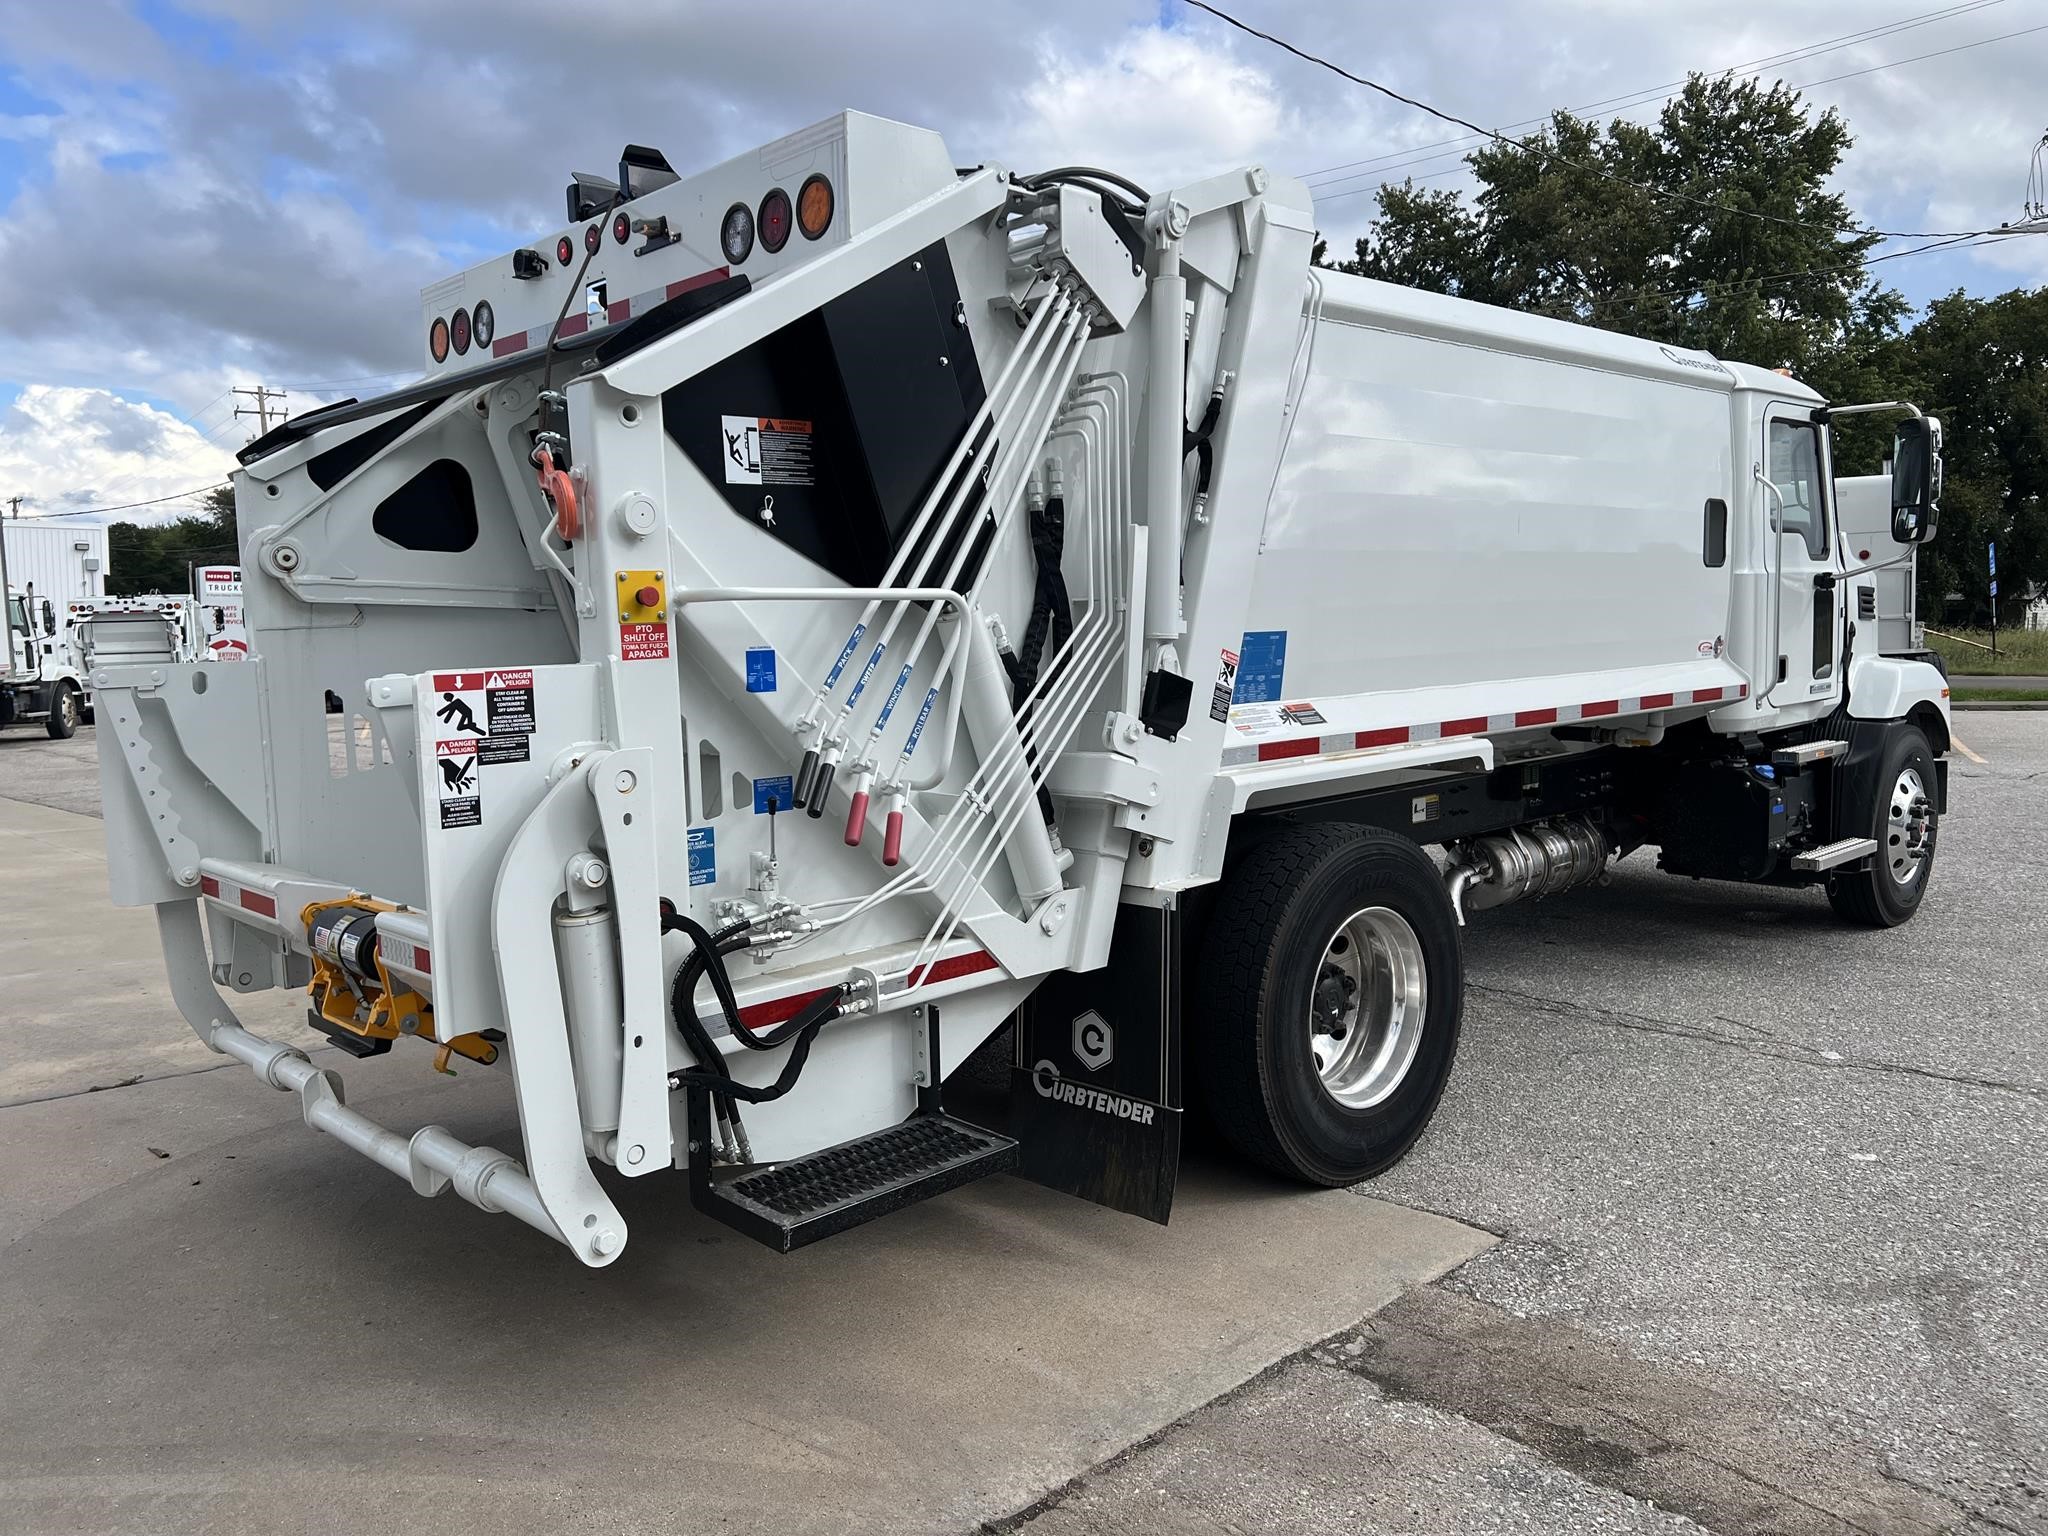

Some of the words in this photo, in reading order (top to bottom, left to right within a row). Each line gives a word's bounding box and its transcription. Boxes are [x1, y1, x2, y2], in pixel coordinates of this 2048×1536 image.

[635, 625, 653, 633] PTO
[623, 634, 646, 642] SHUT
[648, 632, 665, 641] OFF
[628, 650, 664, 659] APAGAR
[837, 647, 852, 668] PACK
[502, 672, 532, 680] DANGER
[886, 684, 903, 710] WINCH
[912, 706, 930, 739] ROLLBAR
[449, 740, 476, 748] DANGER
[1032, 1059, 1155, 1126] CURBTENDER
